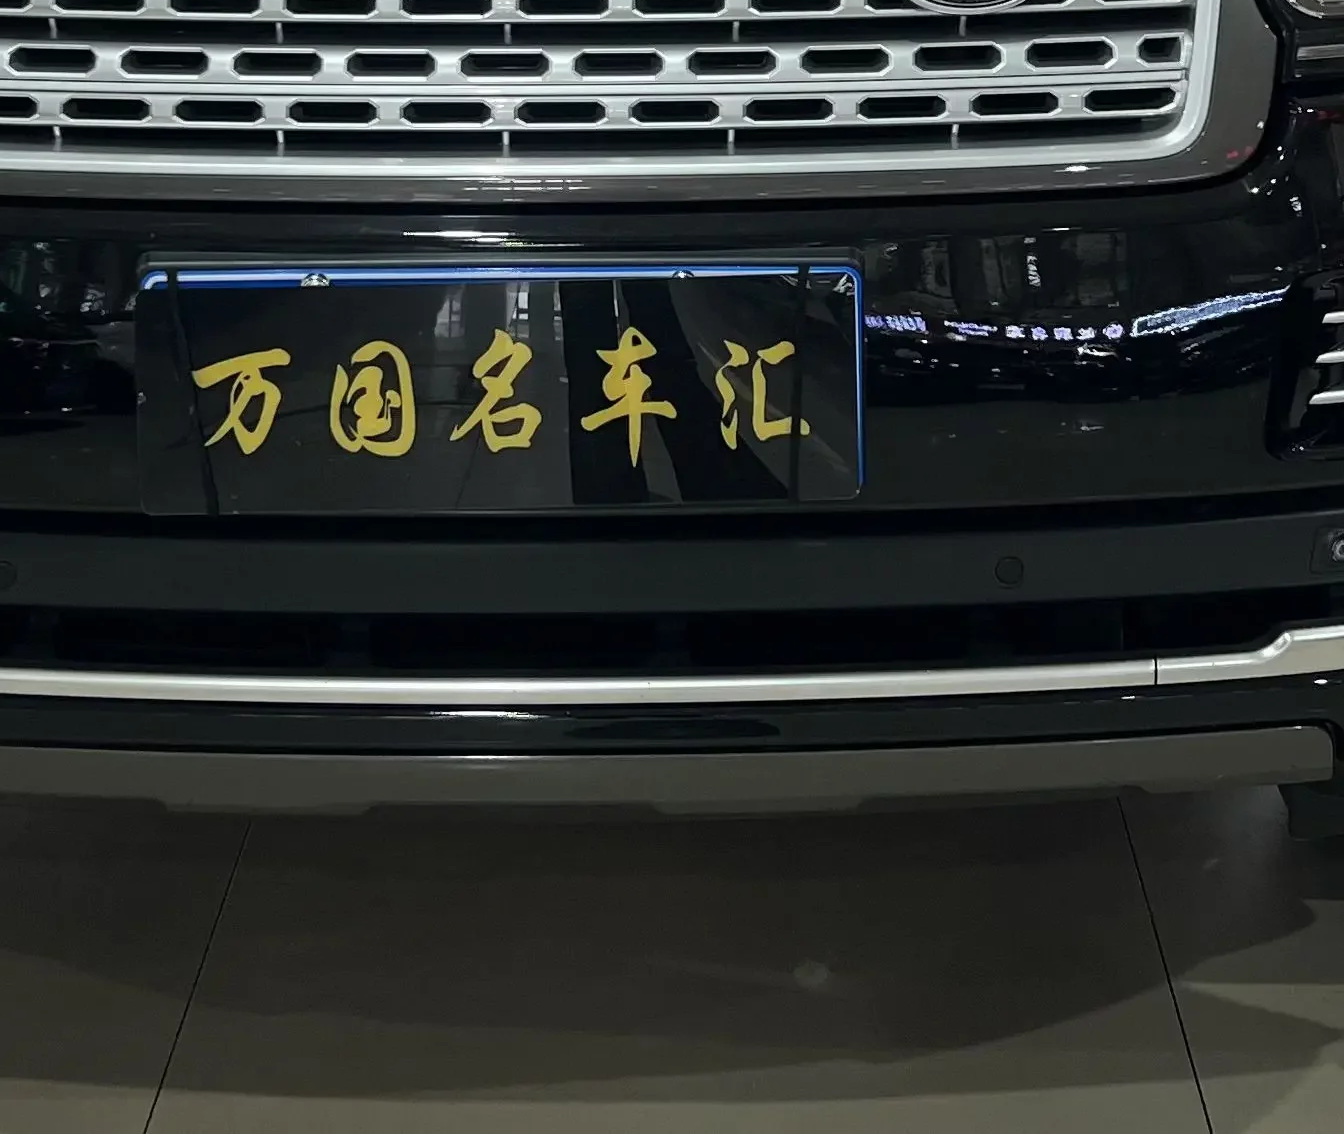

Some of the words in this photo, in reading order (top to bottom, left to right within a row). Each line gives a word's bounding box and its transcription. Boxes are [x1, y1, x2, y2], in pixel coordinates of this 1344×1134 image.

[192, 326, 811, 468] 万国名车汇
